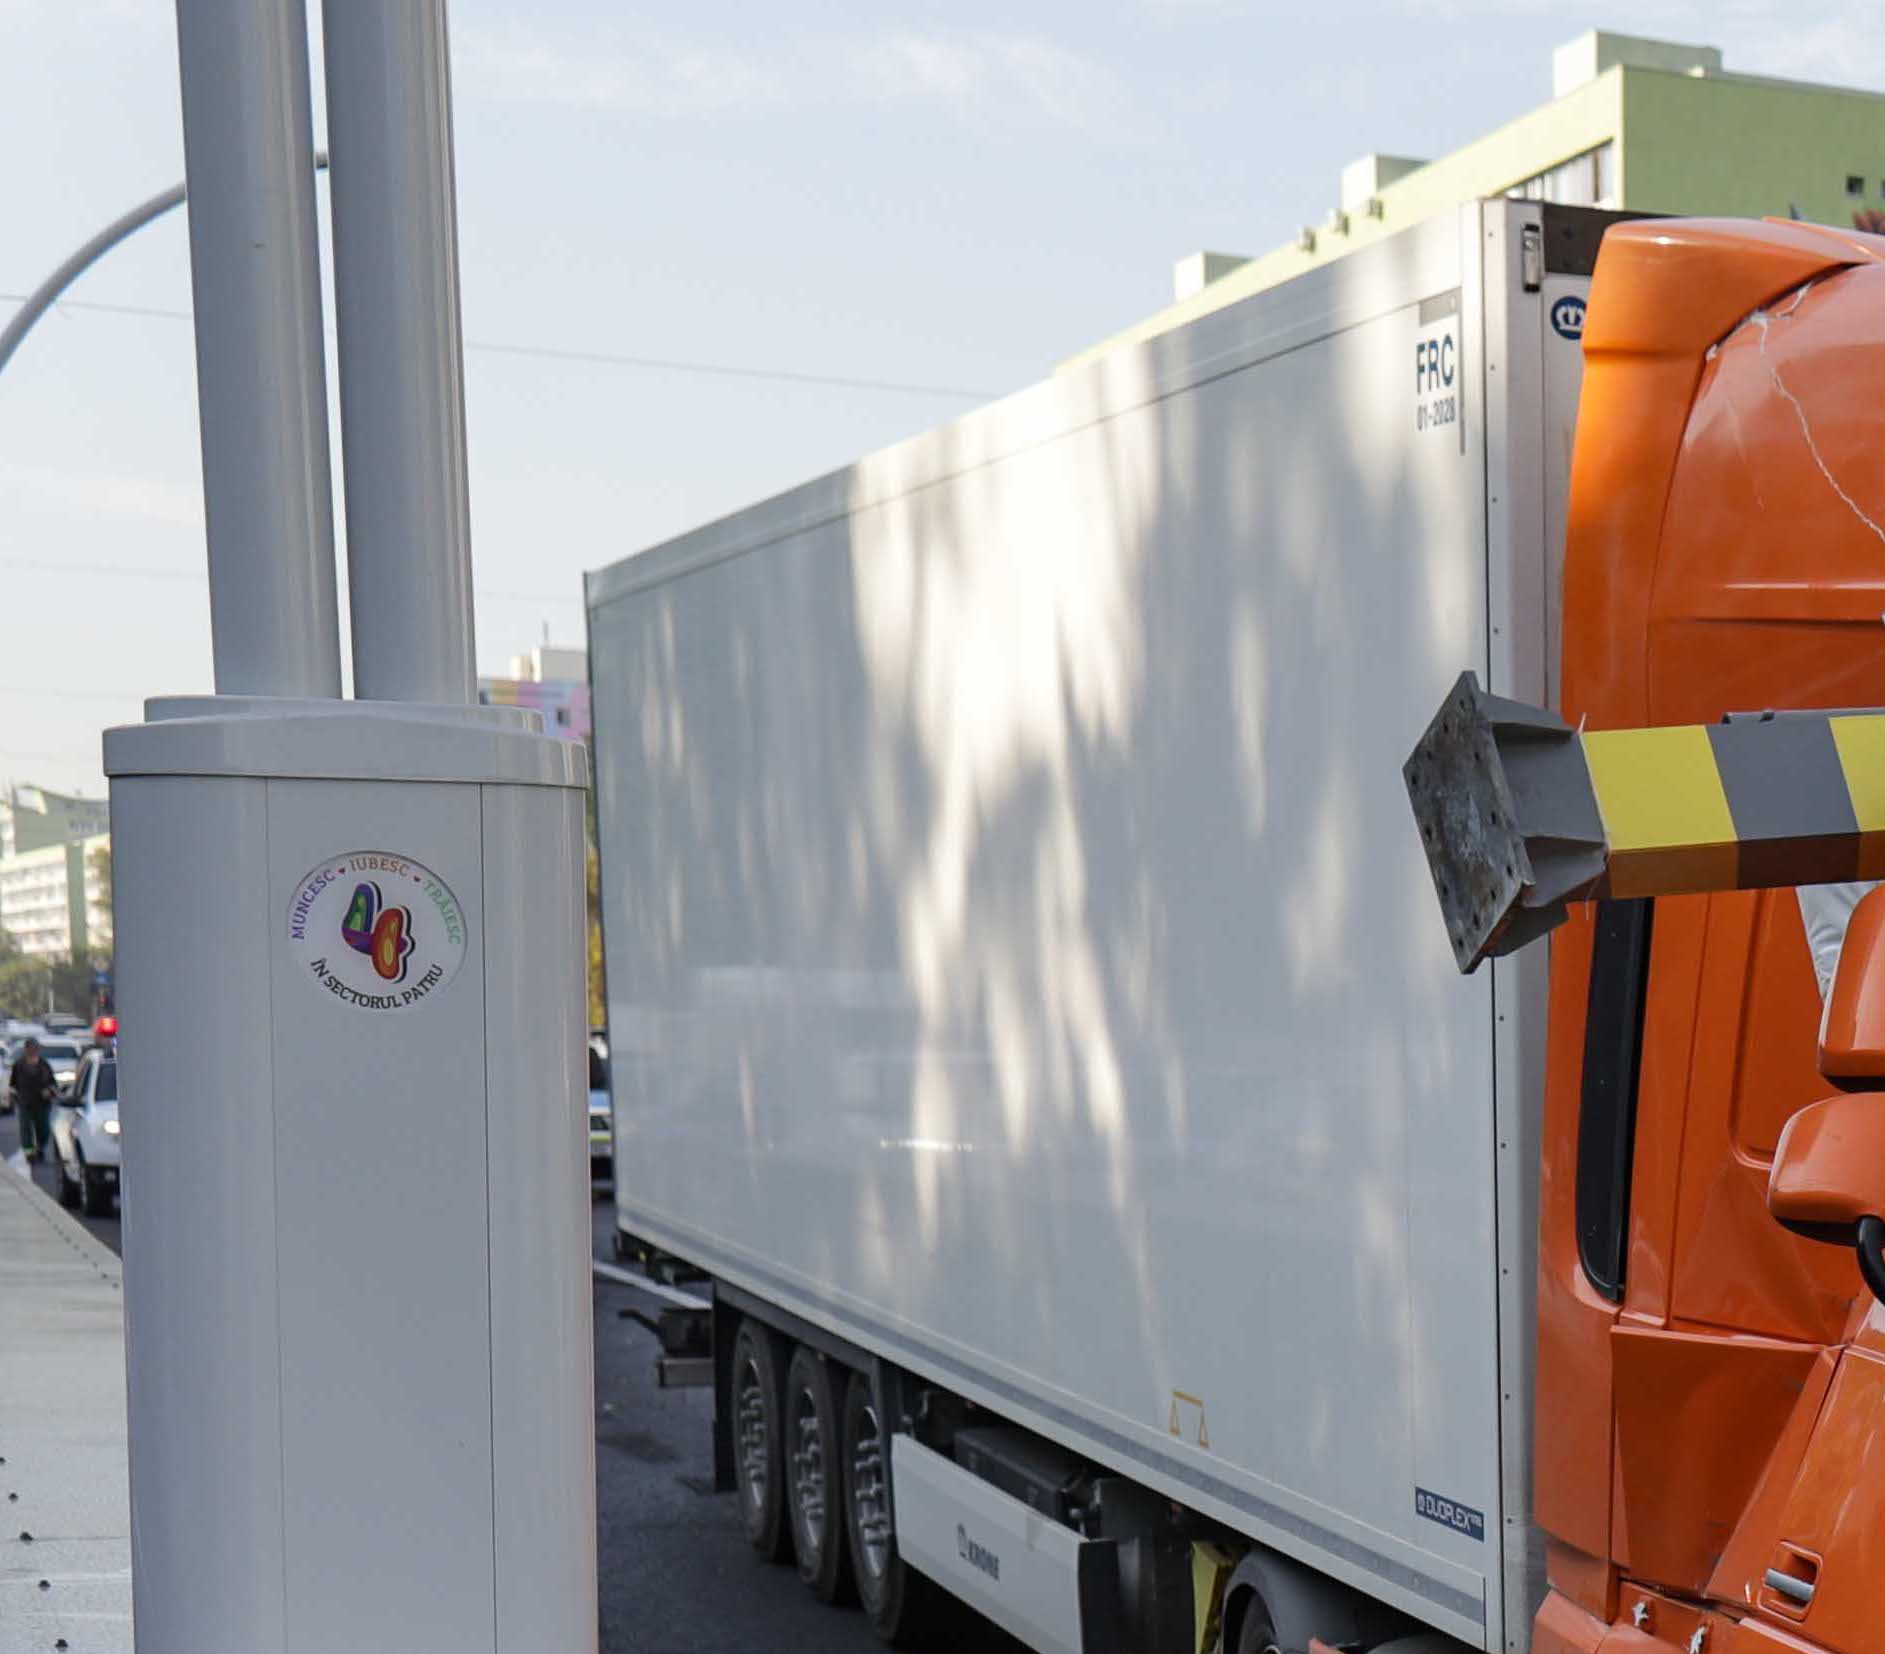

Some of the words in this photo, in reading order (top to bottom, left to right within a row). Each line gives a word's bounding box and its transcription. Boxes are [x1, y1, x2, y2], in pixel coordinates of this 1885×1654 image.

[1416, 334, 1454, 395] FRC
[292, 869, 336, 940] MUNCESC
[350, 857, 411, 877] IUBESC
[324, 974, 402, 1009] SECTORUL
[400, 963, 443, 1004] PATRU
